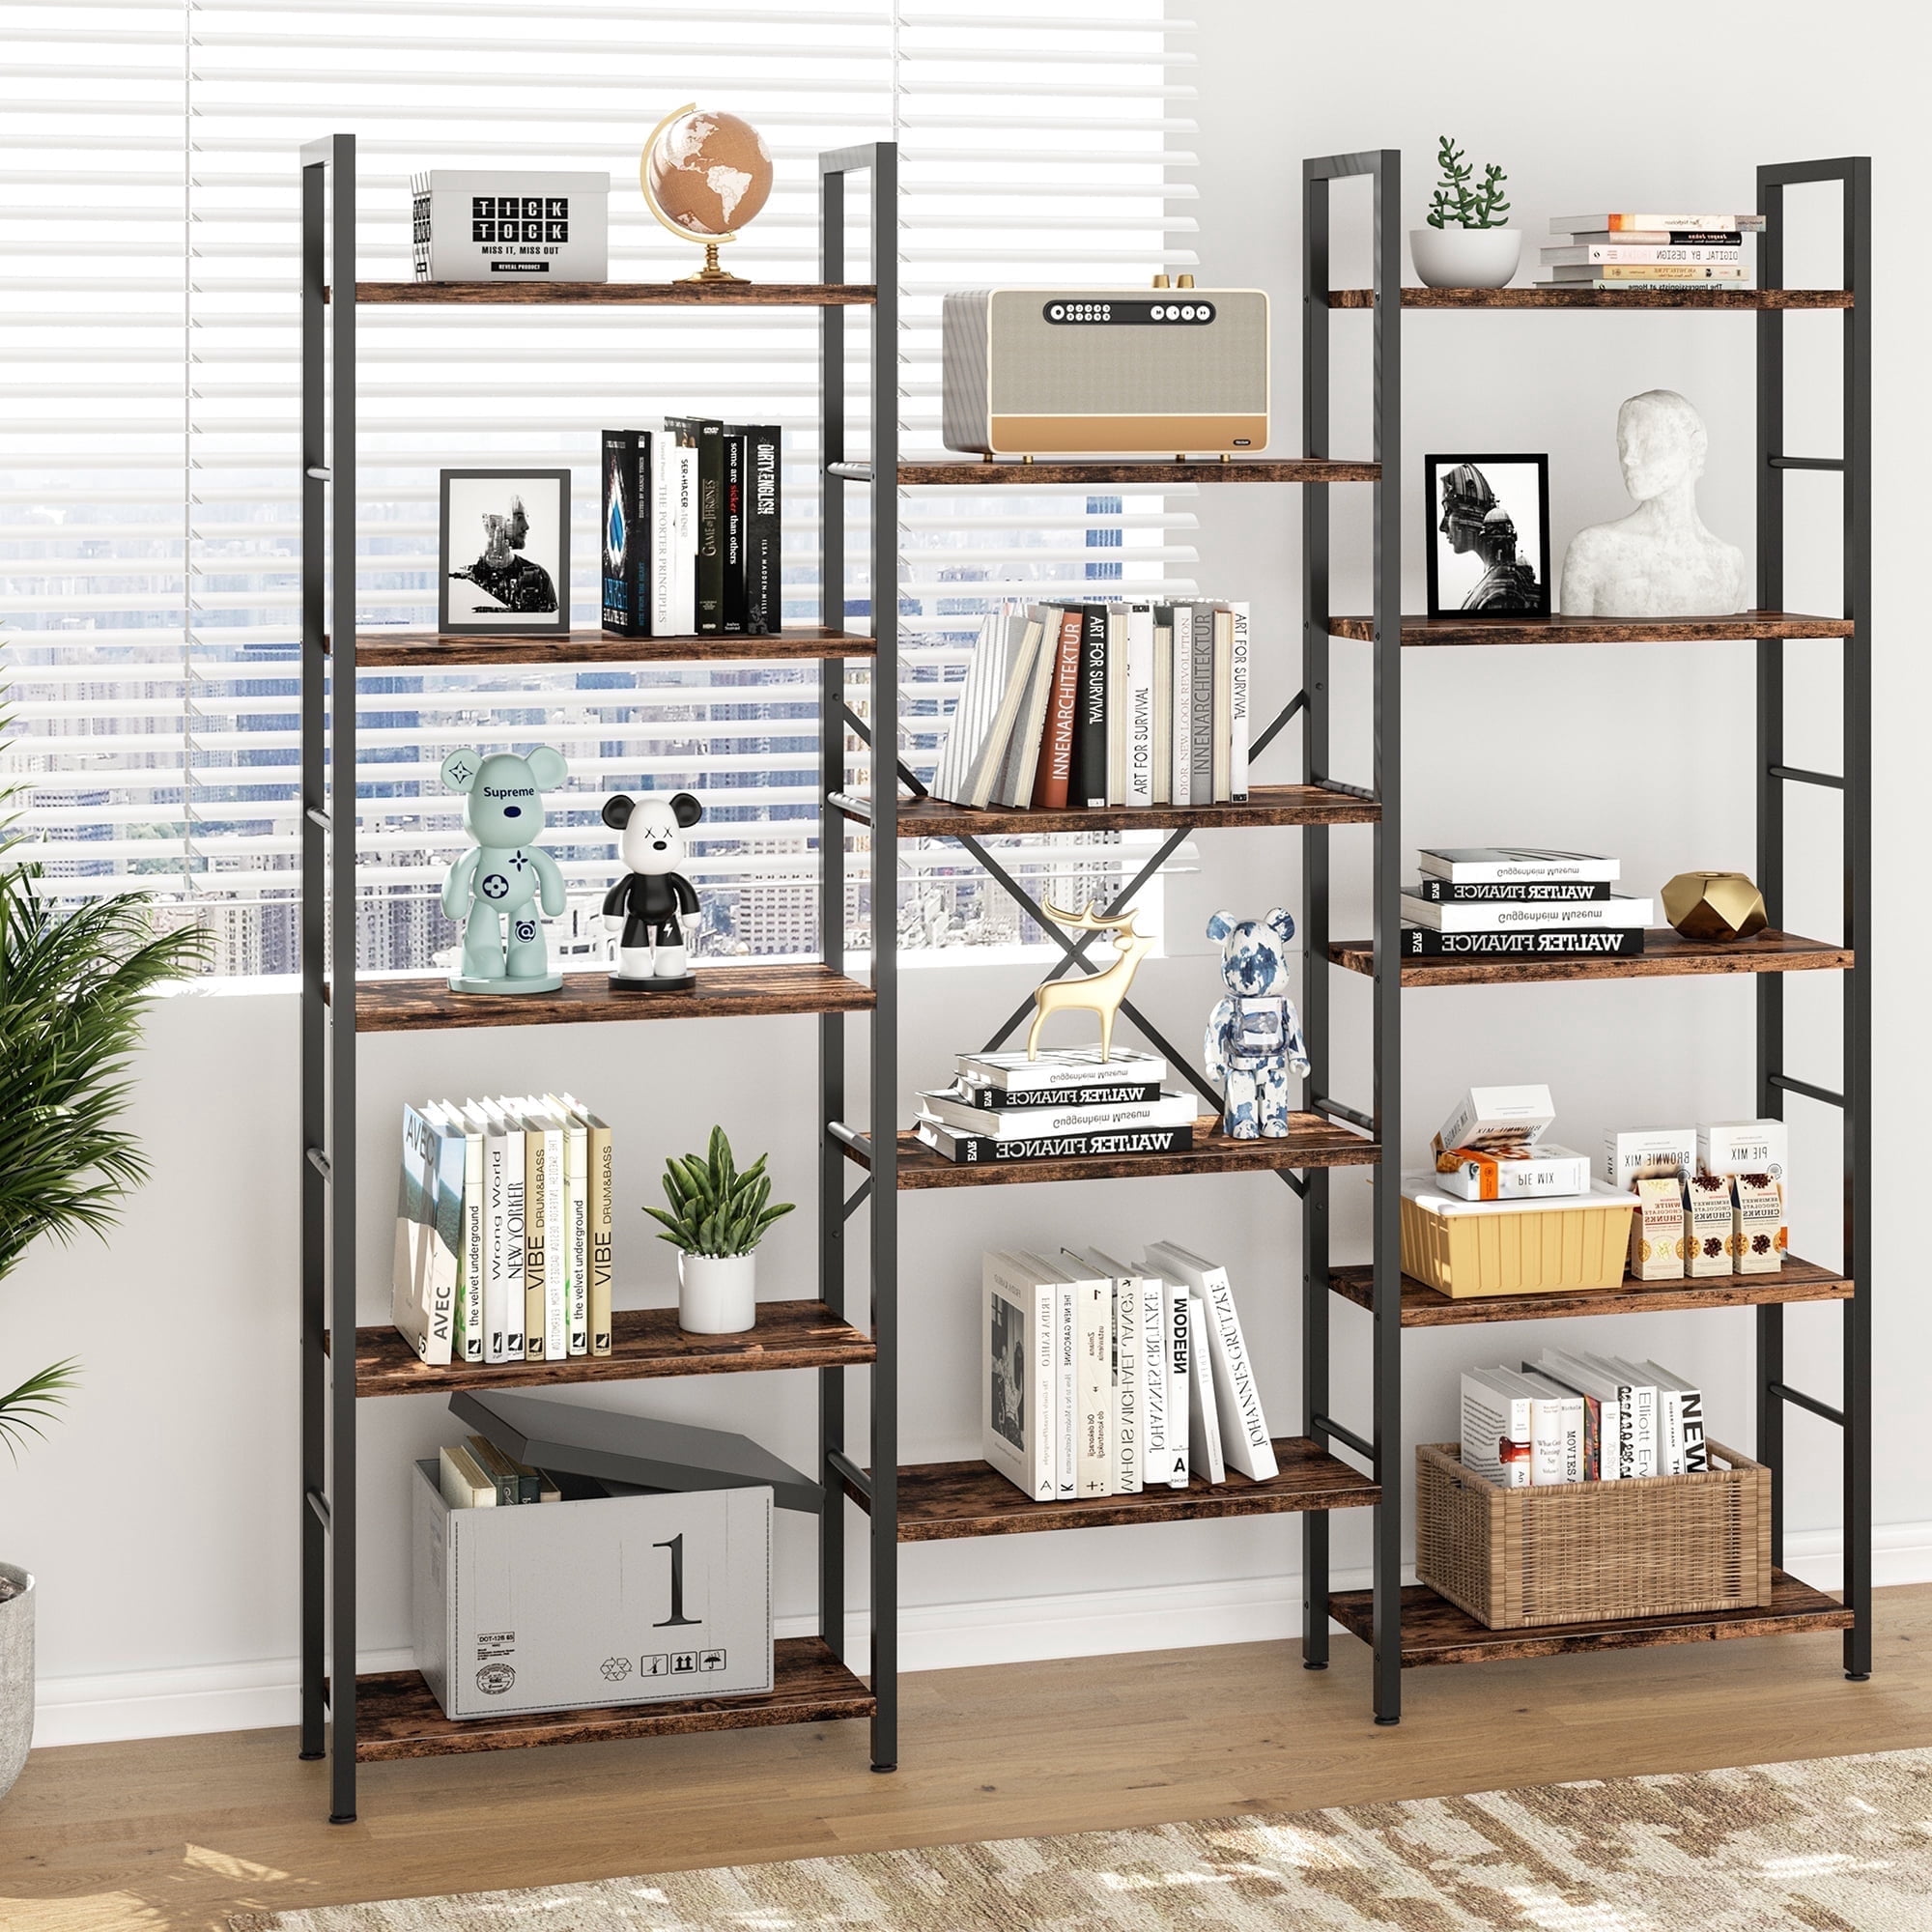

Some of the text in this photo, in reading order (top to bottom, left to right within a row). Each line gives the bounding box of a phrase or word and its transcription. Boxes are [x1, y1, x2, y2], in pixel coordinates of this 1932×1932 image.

[479, 200, 562, 217] TICK
[479, 223, 562, 240] TOCK
[481, 245, 559, 256] MISS IT, MISS OUT
[702, 478, 717, 556] GAME THRONES
[729, 485, 739, 514] sicker
[729, 515, 739, 535] than
[659, 484, 668, 623] THE PORTER PRINCIPLES
[729, 536, 739, 565] others
[1089, 615, 1104, 724] ART FOR SURVIVAL
[1180, 617, 1190, 695] REVOLUTION
[1193, 614, 1210, 775] INNENARCHITEKTUR
[1234, 612, 1247, 720] ART FOR SURVIVAL
[1052, 623, 1081, 780] INNENARCHITEKTUR
[1133, 687, 1149, 795] ART FOR SURVIVAL
[1180, 697, 1190, 731] LOOK
[1179, 733, 1189, 761] NEW
[483, 786, 535, 800] Supreme
[406, 1114, 436, 1167] AVEC
[492, 1151, 503, 1280] Wrong World
[507, 1181, 525, 1279] NEW YORKER
[527, 1149, 545, 1291] VIBE DRUM&BASS
[594, 1145, 612, 1286] VIBE DRUM&BASS
[469, 1205, 481, 1326] the velvet underground
[573, 1200, 585, 1320] the velvet underground
[434, 1286, 451, 1341] AVEC
[1232, 1361, 1268, 1447] JOHANNES
[1638, 1392, 1652, 1442] Elliott
[1681, 1393, 1707, 1474] NEW
[1567, 1430, 1577, 1476] MOVIES
[652, 1532, 702, 1628] 1
